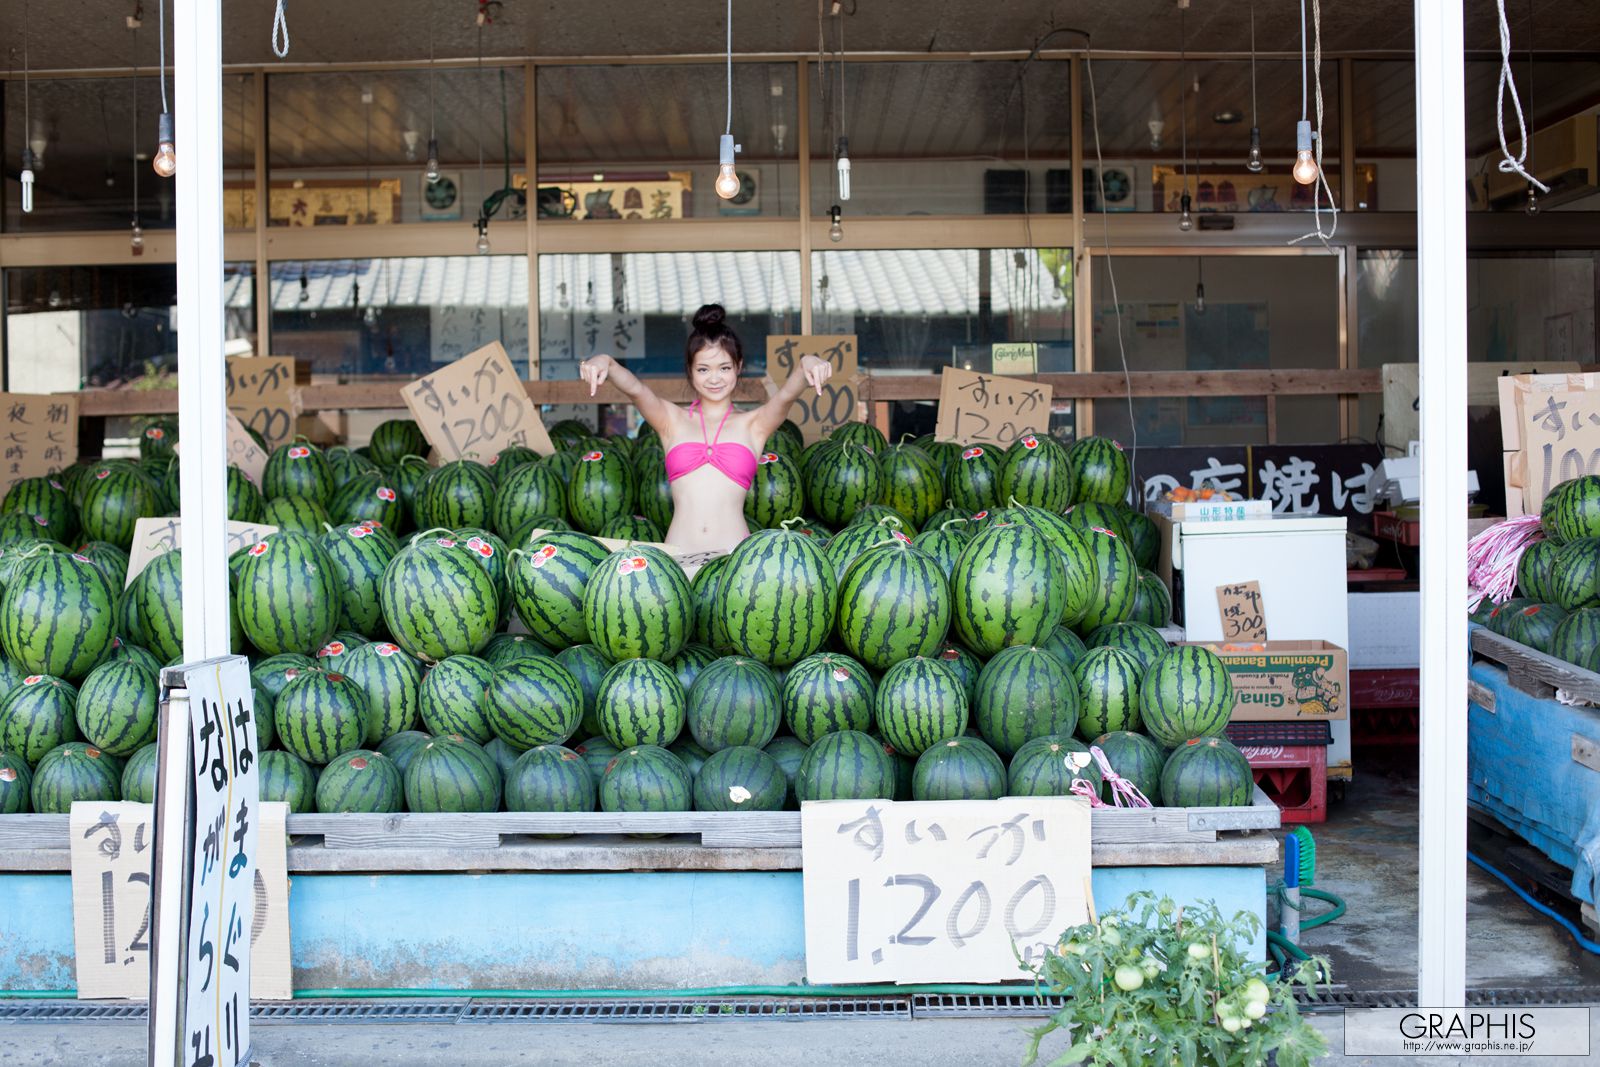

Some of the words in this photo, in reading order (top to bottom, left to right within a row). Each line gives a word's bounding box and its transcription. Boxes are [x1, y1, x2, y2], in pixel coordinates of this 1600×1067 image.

[774, 338, 853, 379] すか
[414, 356, 504, 417] すいか
[958, 375, 1044, 416] すいか
[1270, 656, 1329, 667] Premium
[836, 805, 1047, 866] すいか
[224, 697, 254, 1066] はまぐり
